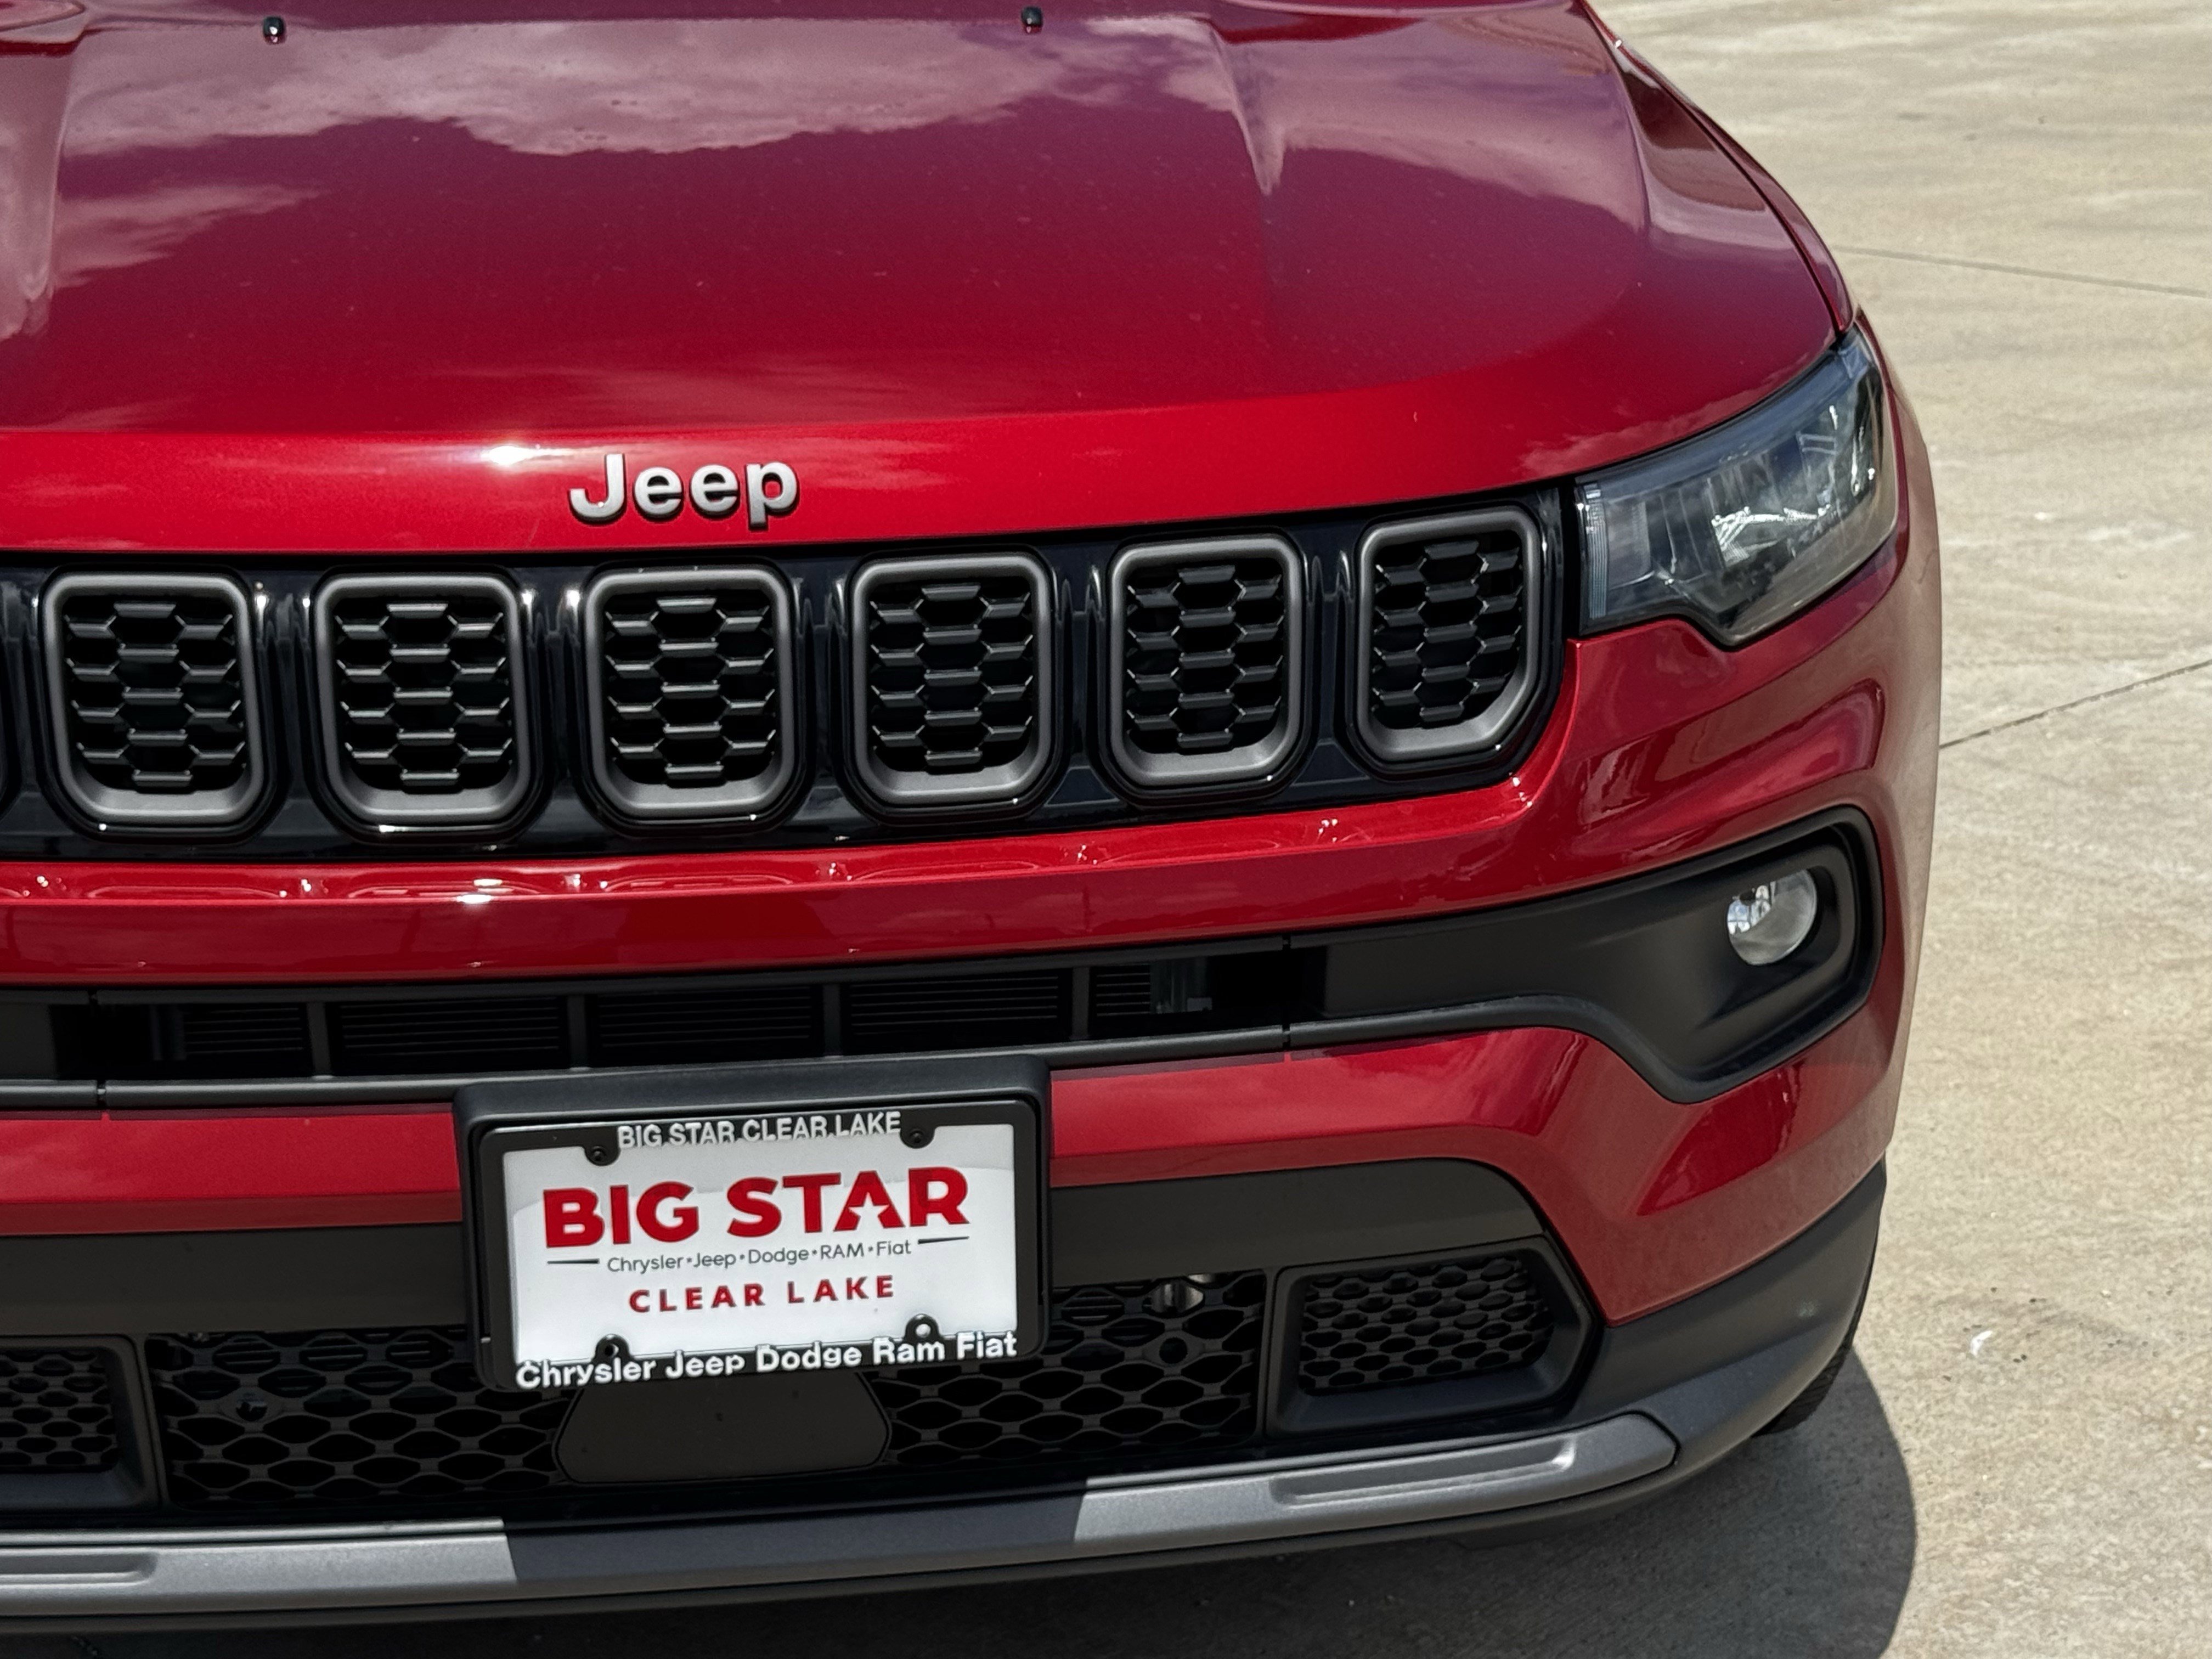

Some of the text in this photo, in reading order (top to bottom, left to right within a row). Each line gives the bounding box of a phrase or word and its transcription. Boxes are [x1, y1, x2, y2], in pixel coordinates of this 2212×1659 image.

[569, 453, 799, 530] Jeep
[618, 1111, 901, 1149] BIG STAR CLEAR LAKE
[543, 1166, 970, 1248] BIG STAR
[607, 1239, 912, 1274] Chrysler Jeep Dodge RAM Fiat
[629, 1275, 894, 1313] CLEAR LAKE
[516, 1330, 1018, 1389] Chrysler Jeep Dodge Ram Fiat
